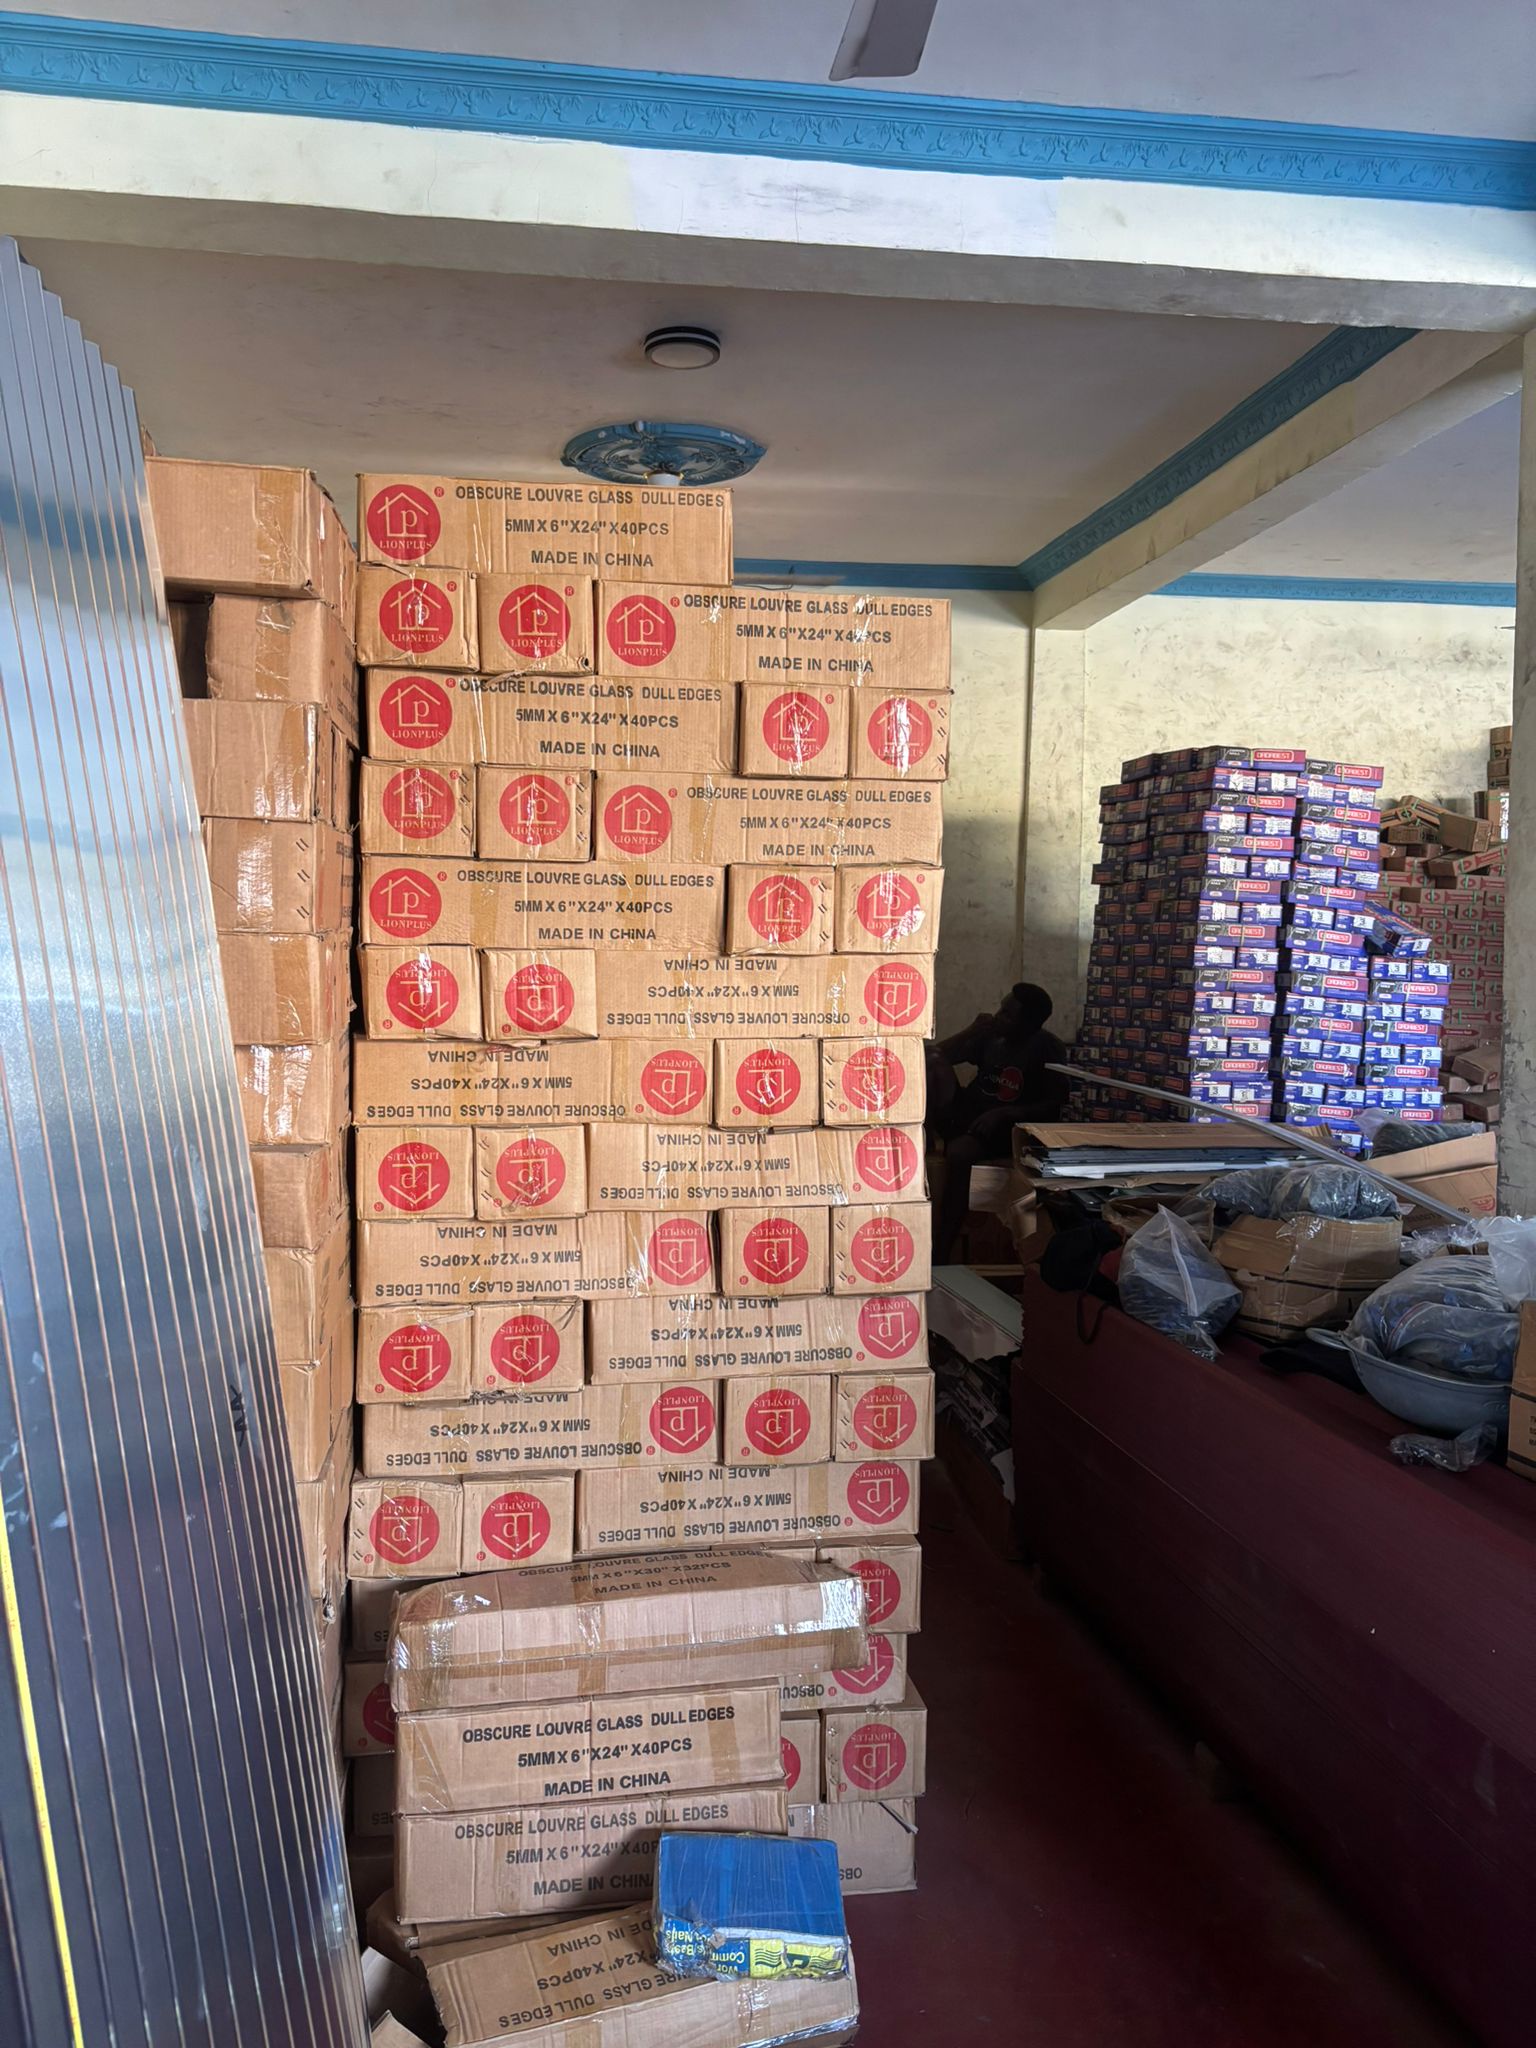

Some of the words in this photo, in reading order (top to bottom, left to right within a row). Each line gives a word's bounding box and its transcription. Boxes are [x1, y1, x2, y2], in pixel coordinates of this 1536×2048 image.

[456, 486, 522, 500] OBSCURE
[528, 488, 583, 502] LOUVRE
[588, 491, 633, 504] GLASS
[379, 540, 433, 549] LIONPLUS
[531, 550, 578, 564] MADE
[583, 552, 597, 564] IN
[605, 553, 653, 567] CHINA
[750, 597, 802, 612] LOUVRE
[806, 601, 848, 614] GLASS
[617, 647, 667, 657] LIONPLUS
[759, 656, 802, 670] MADE
[808, 658, 821, 670] IN
[530, 681, 585, 696] LOUVRE
[589, 684, 633, 699] GLASS
[392, 729, 444, 739] LIONPLUS
[540, 740, 586, 755] MADE
[591, 743, 606, 755] IN
[613, 744, 660, 758] CHINA
[687, 787, 747, 799] OBSCURE
[752, 788, 803, 801] LOUVRE
[807, 789, 847, 802] GLASS
[614, 836, 662, 846] LIONPLUS
[763, 844, 805, 856] MADE
[811, 844, 824, 856] IN
[830, 844, 875, 856] CHINA
[457, 870, 521, 883] OBSCURE
[527, 872, 580, 885] LOUVRE
[584, 873, 627, 886] GLASS
[380, 919, 432, 930] LIONPLUS
[539, 928, 583, 939] MADE
[589, 928, 603, 939] IN
[610, 928, 656, 940] CHINA
[664, 959, 709, 971] CHINA
[715, 960, 729, 971] IN
[735, 959, 777, 971] MADE
[694, 1012, 734, 1024] GLASS
[738, 1012, 787, 1024] LOUVRE
[428, 1050, 477, 1062] CHINA
[484, 1050, 499, 1063] IN
[504, 1050, 548, 1062] MADE
[460, 1104, 504, 1117] GLASS
[507, 1104, 560, 1117] LOUVRE
[565, 1105, 626, 1117] OBSCURE
[657, 1134, 704, 1145] CHINA
[708, 1134, 721, 1145] IN
[687, 1186, 728, 1198] GLASS
[731, 1186, 781, 1198] LOUVRE
[493, 1226, 507, 1238] IN
[512, 1224, 557, 1237] MADE
[469, 1281, 513, 1294] GLASS
[516, 1280, 569, 1293] LOUVRE
[717, 1298, 733, 1310] IN
[737, 1297, 779, 1309] MADE
[500, 1323, 550, 1334] LIONPLUS
[388, 1334, 440, 1344] LIONPLUS
[695, 1353, 736, 1367] GLASS
[741, 1351, 791, 1365] LOUVRE
[795, 1347, 852, 1362] OBSCURE
[476, 1448, 520, 1462] GLASS
[524, 1445, 577, 1460] LOUVRE
[581, 1442, 642, 1457] OBSCURE
[658, 1470, 703, 1483] CHINA
[709, 1468, 723, 1480] IN
[728, 1467, 770, 1479] MADE
[729, 1519, 779, 1533] LOUVRE
[783, 1515, 841, 1530] OBSCURE
[684, 1522, 725, 1537] GLASS
[463, 1724, 531, 1743] OBSCURE
[536, 1719, 592, 1738] LOUVRE
[597, 1714, 643, 1732] GLASS
[545, 1779, 593, 1797] MADE
[598, 1774, 614, 1791] IN
[620, 1771, 671, 1789] CHINA
[455, 1820, 523, 1839] OBSCURE
[528, 1815, 586, 1834] LOUVRE
[590, 1811, 638, 1829] GLASS
[534, 1877, 584, 1896] MADE
[588, 1877, 604, 1891] IN
[608, 1926, 625, 1941] IN
[548, 1934, 602, 1956] CHINA
[604, 1978, 653, 2000] GLASS
